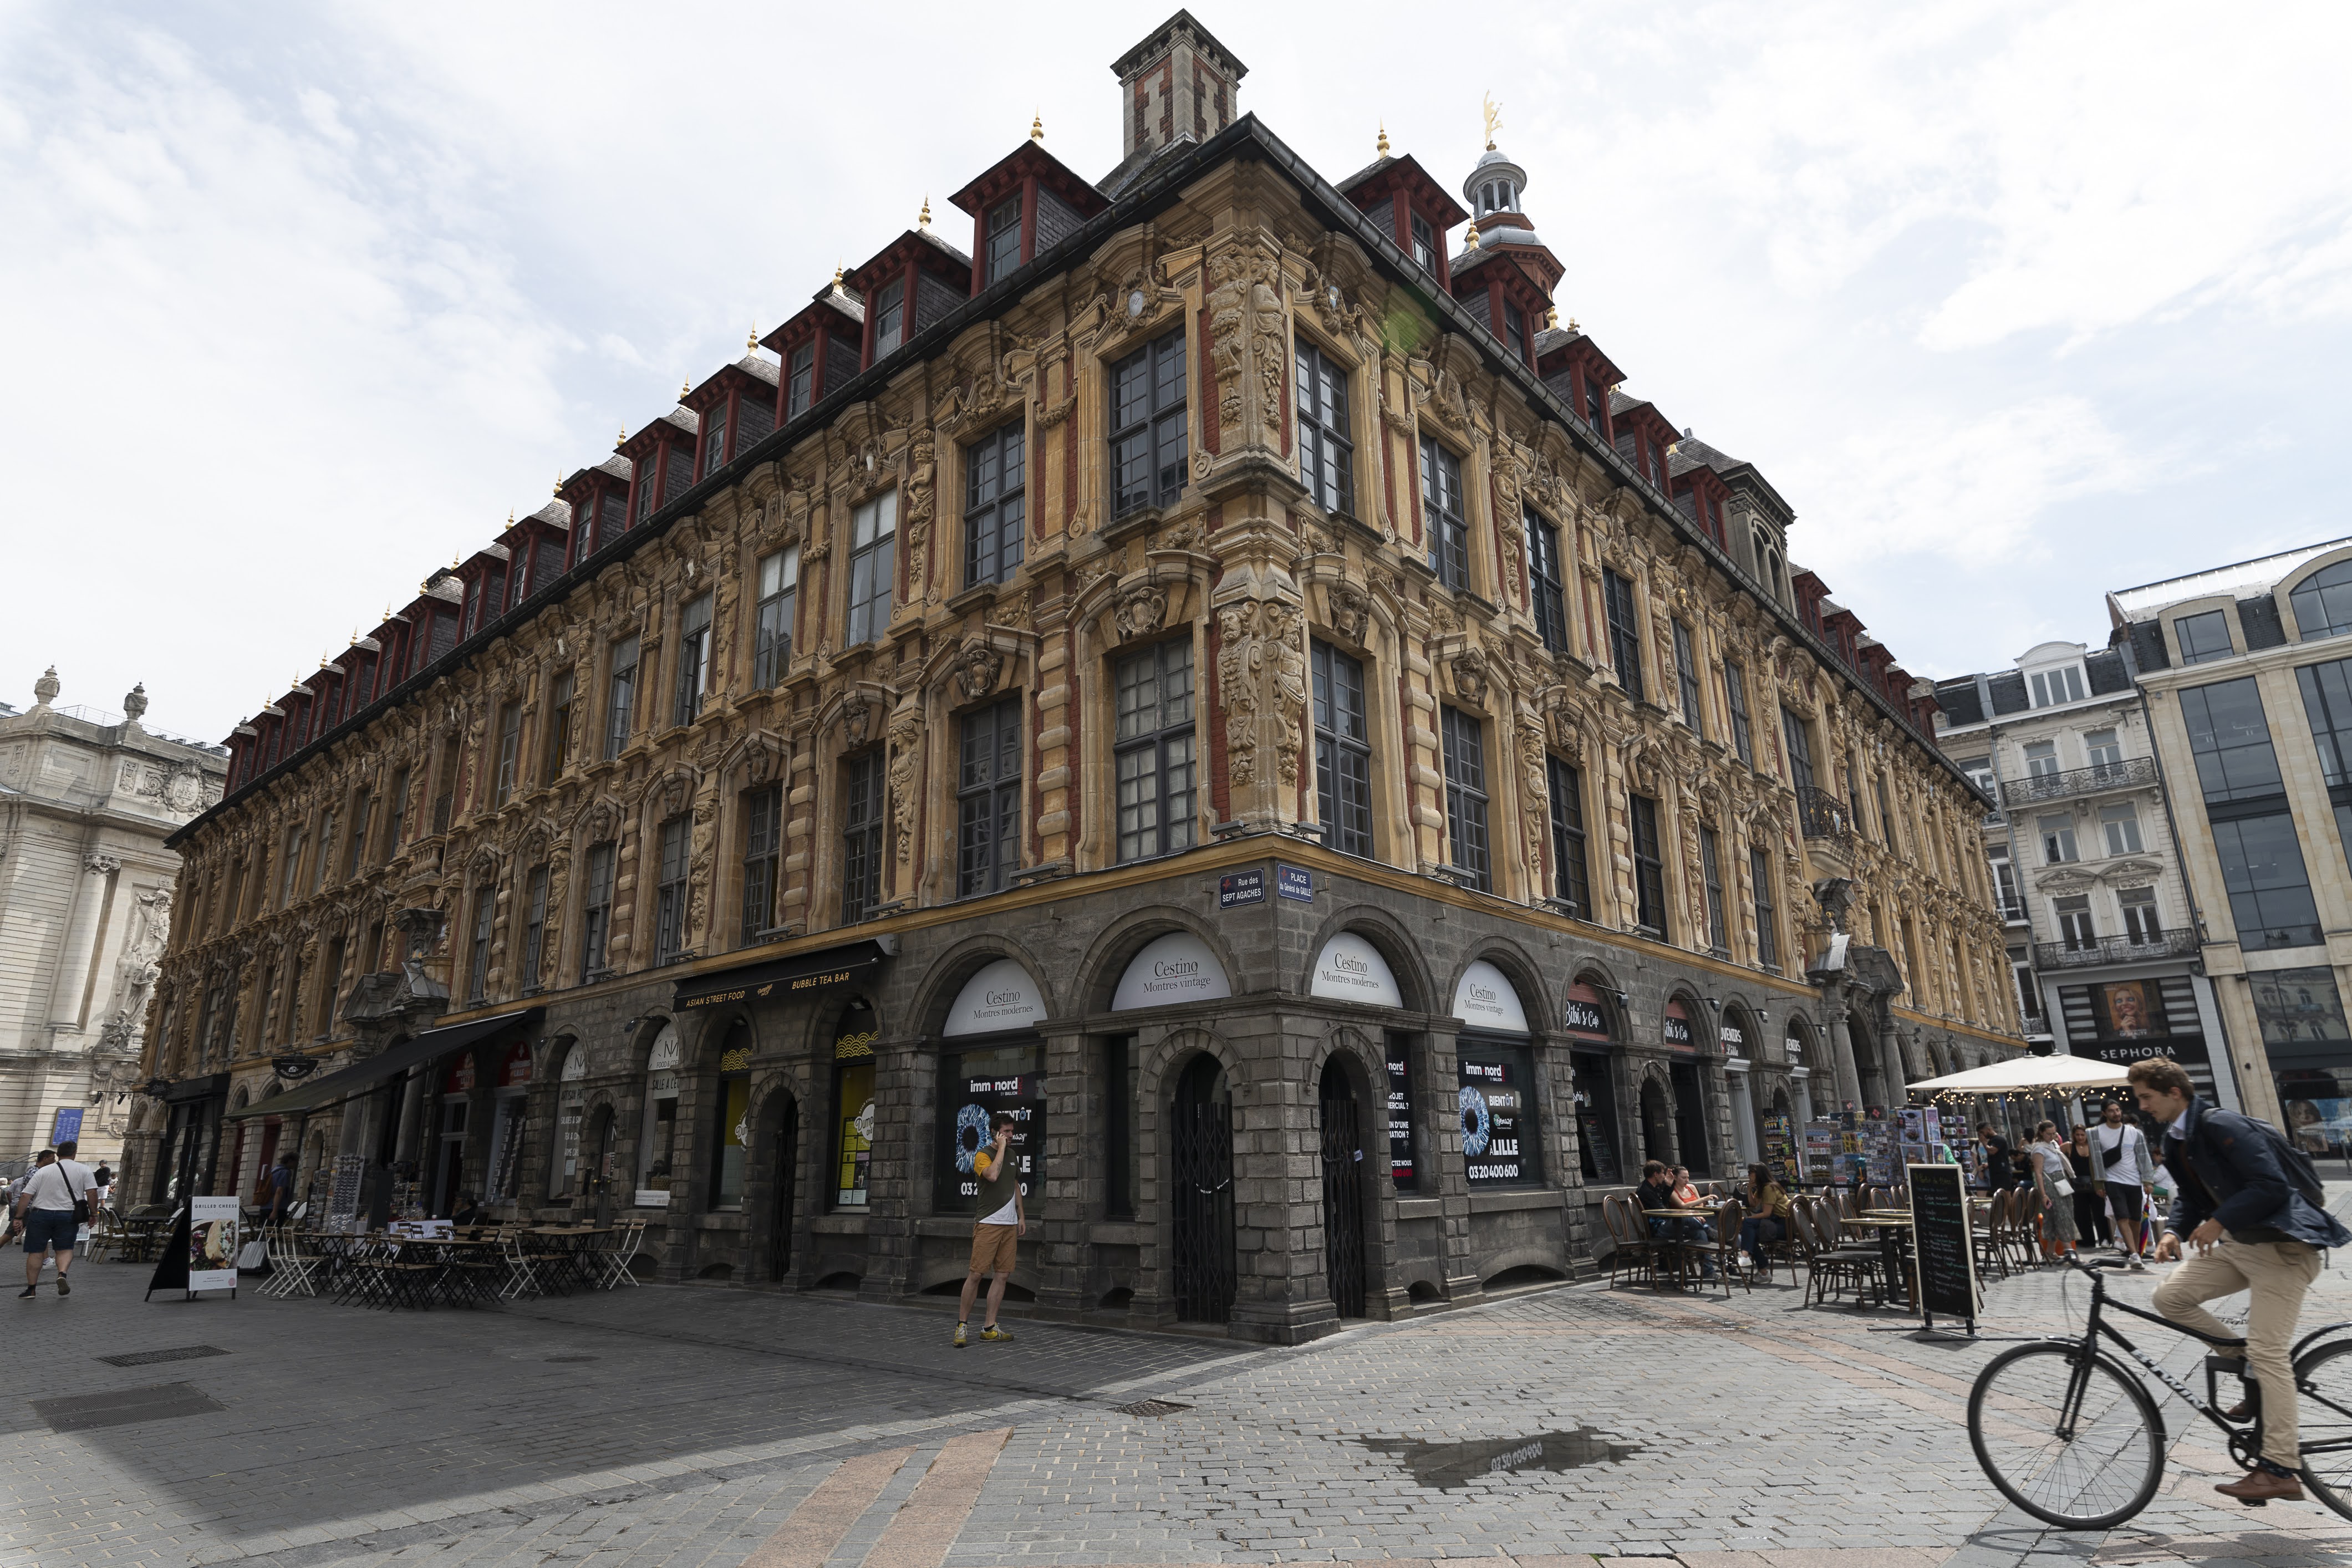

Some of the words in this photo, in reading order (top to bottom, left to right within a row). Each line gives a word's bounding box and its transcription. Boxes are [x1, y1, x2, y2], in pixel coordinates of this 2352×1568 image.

[1238, 878, 1248, 887] Rue
[1249, 877, 1258, 885] des
[1291, 873, 1306, 884] PLACE
[1223, 893, 1235, 902] SEPT
[1236, 888, 1261, 900] AGACHES
[1284, 882, 1295, 893] Général
[1300, 888, 1311, 897] GAULLE
[1155, 958, 1198, 977] Cestino
[1335, 953, 1367, 973] Cestino
[792, 977, 817, 990] BUBBLE
[819, 975, 832, 985] TEA
[834, 972, 849, 982] BAR
[1143, 982, 1178, 993] Montres
[1180, 978, 1211, 989] vintage
[1322, 970, 1350, 984] Montres
[1351, 976, 1379, 989] modernes
[686, 997, 704, 1008] ASIAN
[706, 993, 726, 1005] STREET
[728, 990, 745, 1001] FOOD
[986, 989, 1020, 1005] Cestino
[1470, 983, 1496, 1001] Cestino
[974, 1010, 1000, 1019] Montres
[1001, 1005, 1033, 1016] modernes
[1464, 1000, 1485, 1011] Montres
[1486, 1004, 1504, 1016] vintage
[2100, 1045, 2176, 1060] SEPHORA
[652, 1078, 665, 1091] SALLE
[1489, 1093, 1513, 1107] BIENTÔT
[1489, 1144, 1494, 1155] À
[1493, 1139, 1519, 1155] LILLE
[1469, 1165, 1479, 1179] 03
[1479, 1165, 1489, 1179] 20
[1489, 1164, 1504, 1178] 400
[1504, 1164, 1519, 1178] 600
